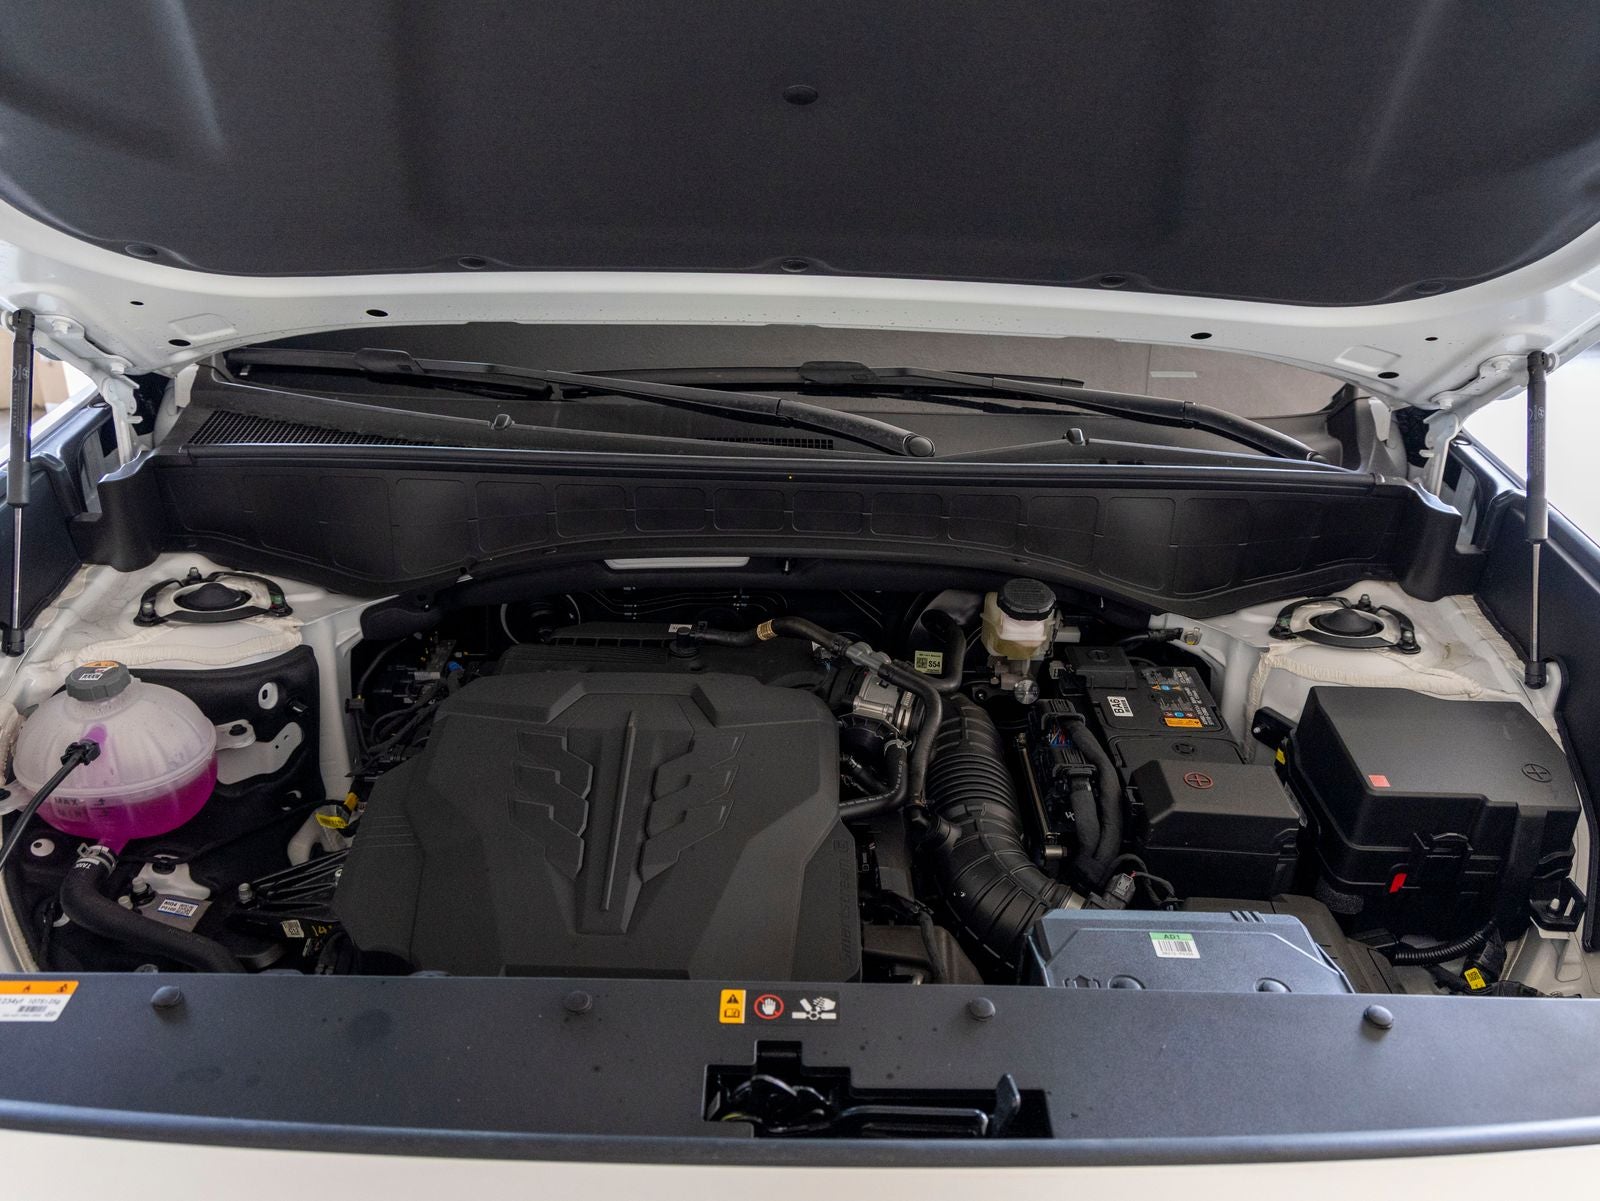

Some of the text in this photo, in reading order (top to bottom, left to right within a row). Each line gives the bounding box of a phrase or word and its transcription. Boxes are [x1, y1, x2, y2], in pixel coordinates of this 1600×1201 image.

[928, 660, 941, 668] S54
[1110, 698, 1124, 714] BA6
[54, 797, 78, 806] MAX
